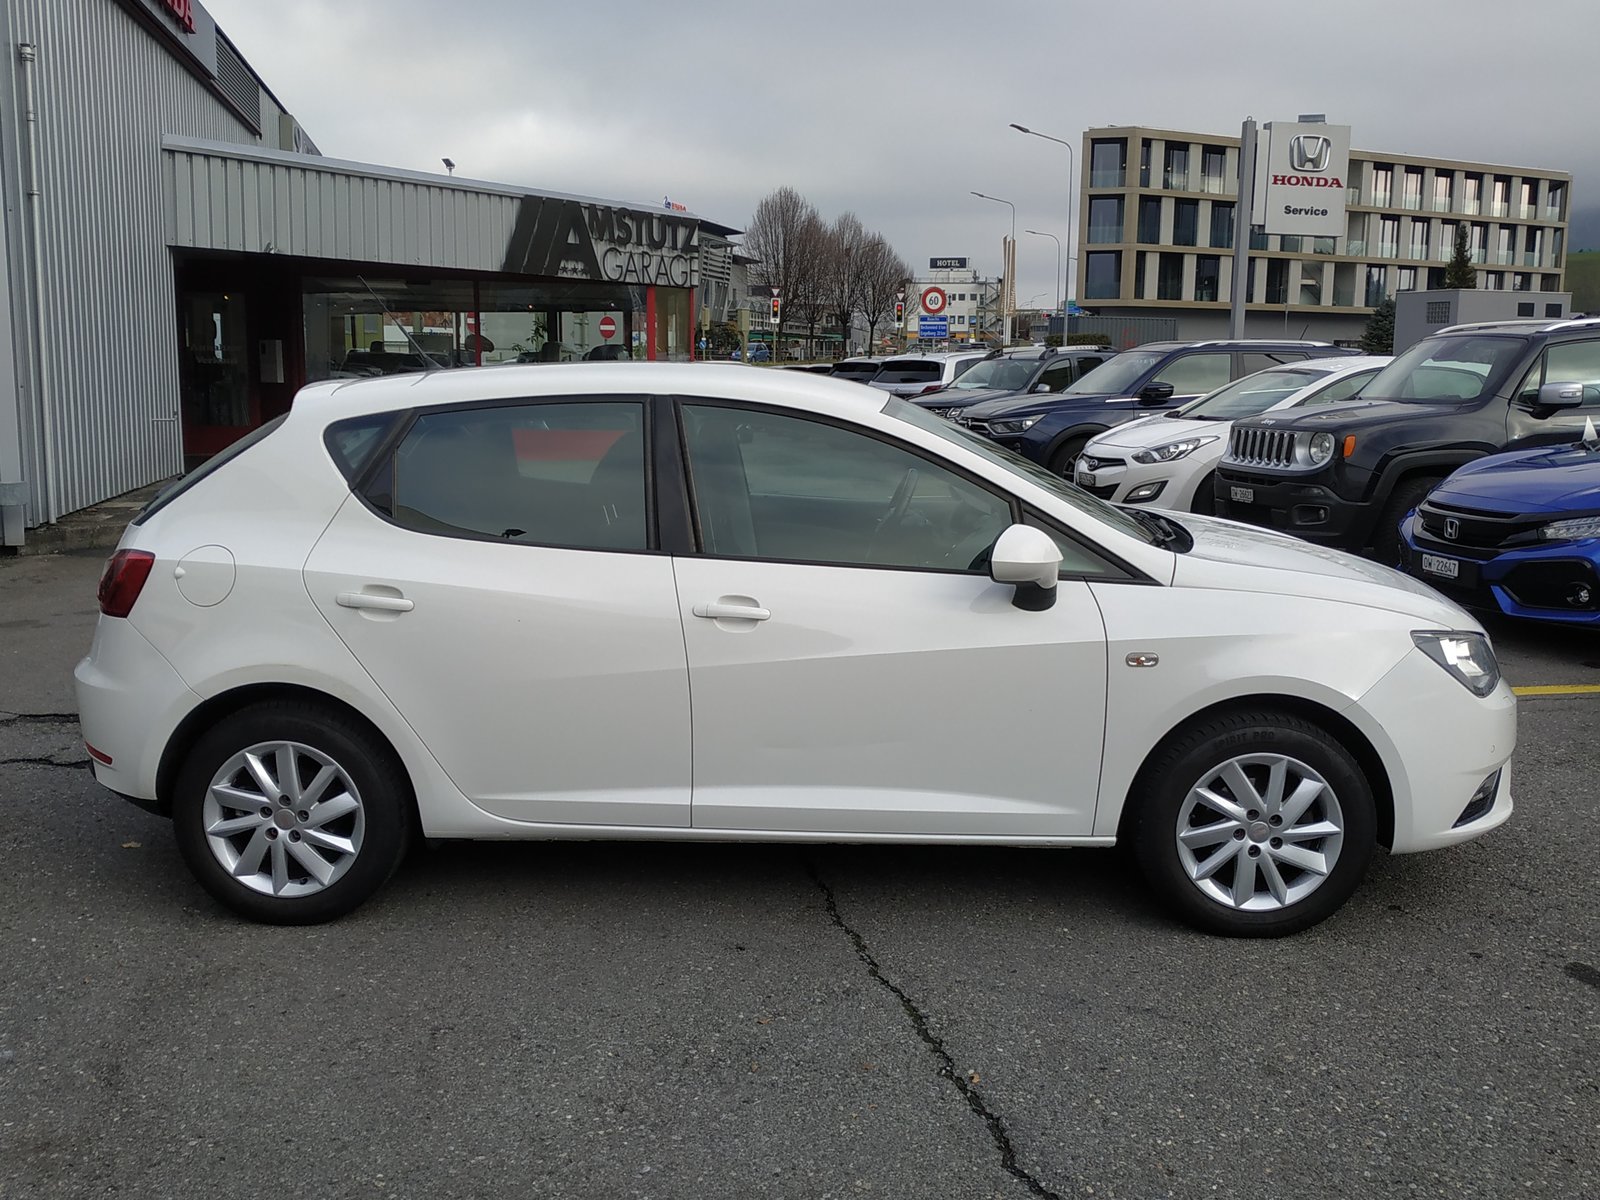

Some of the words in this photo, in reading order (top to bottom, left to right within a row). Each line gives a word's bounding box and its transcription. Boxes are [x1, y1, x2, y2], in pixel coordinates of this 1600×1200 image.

[1272, 174, 1344, 188] HONDA
[1284, 205, 1328, 216] Service
[543, 199, 700, 280] AMSTUTZ
[601, 247, 699, 288] GARAGE
[928, 296, 939, 306] 60
[1216, 732, 1247, 747] PIRIT
